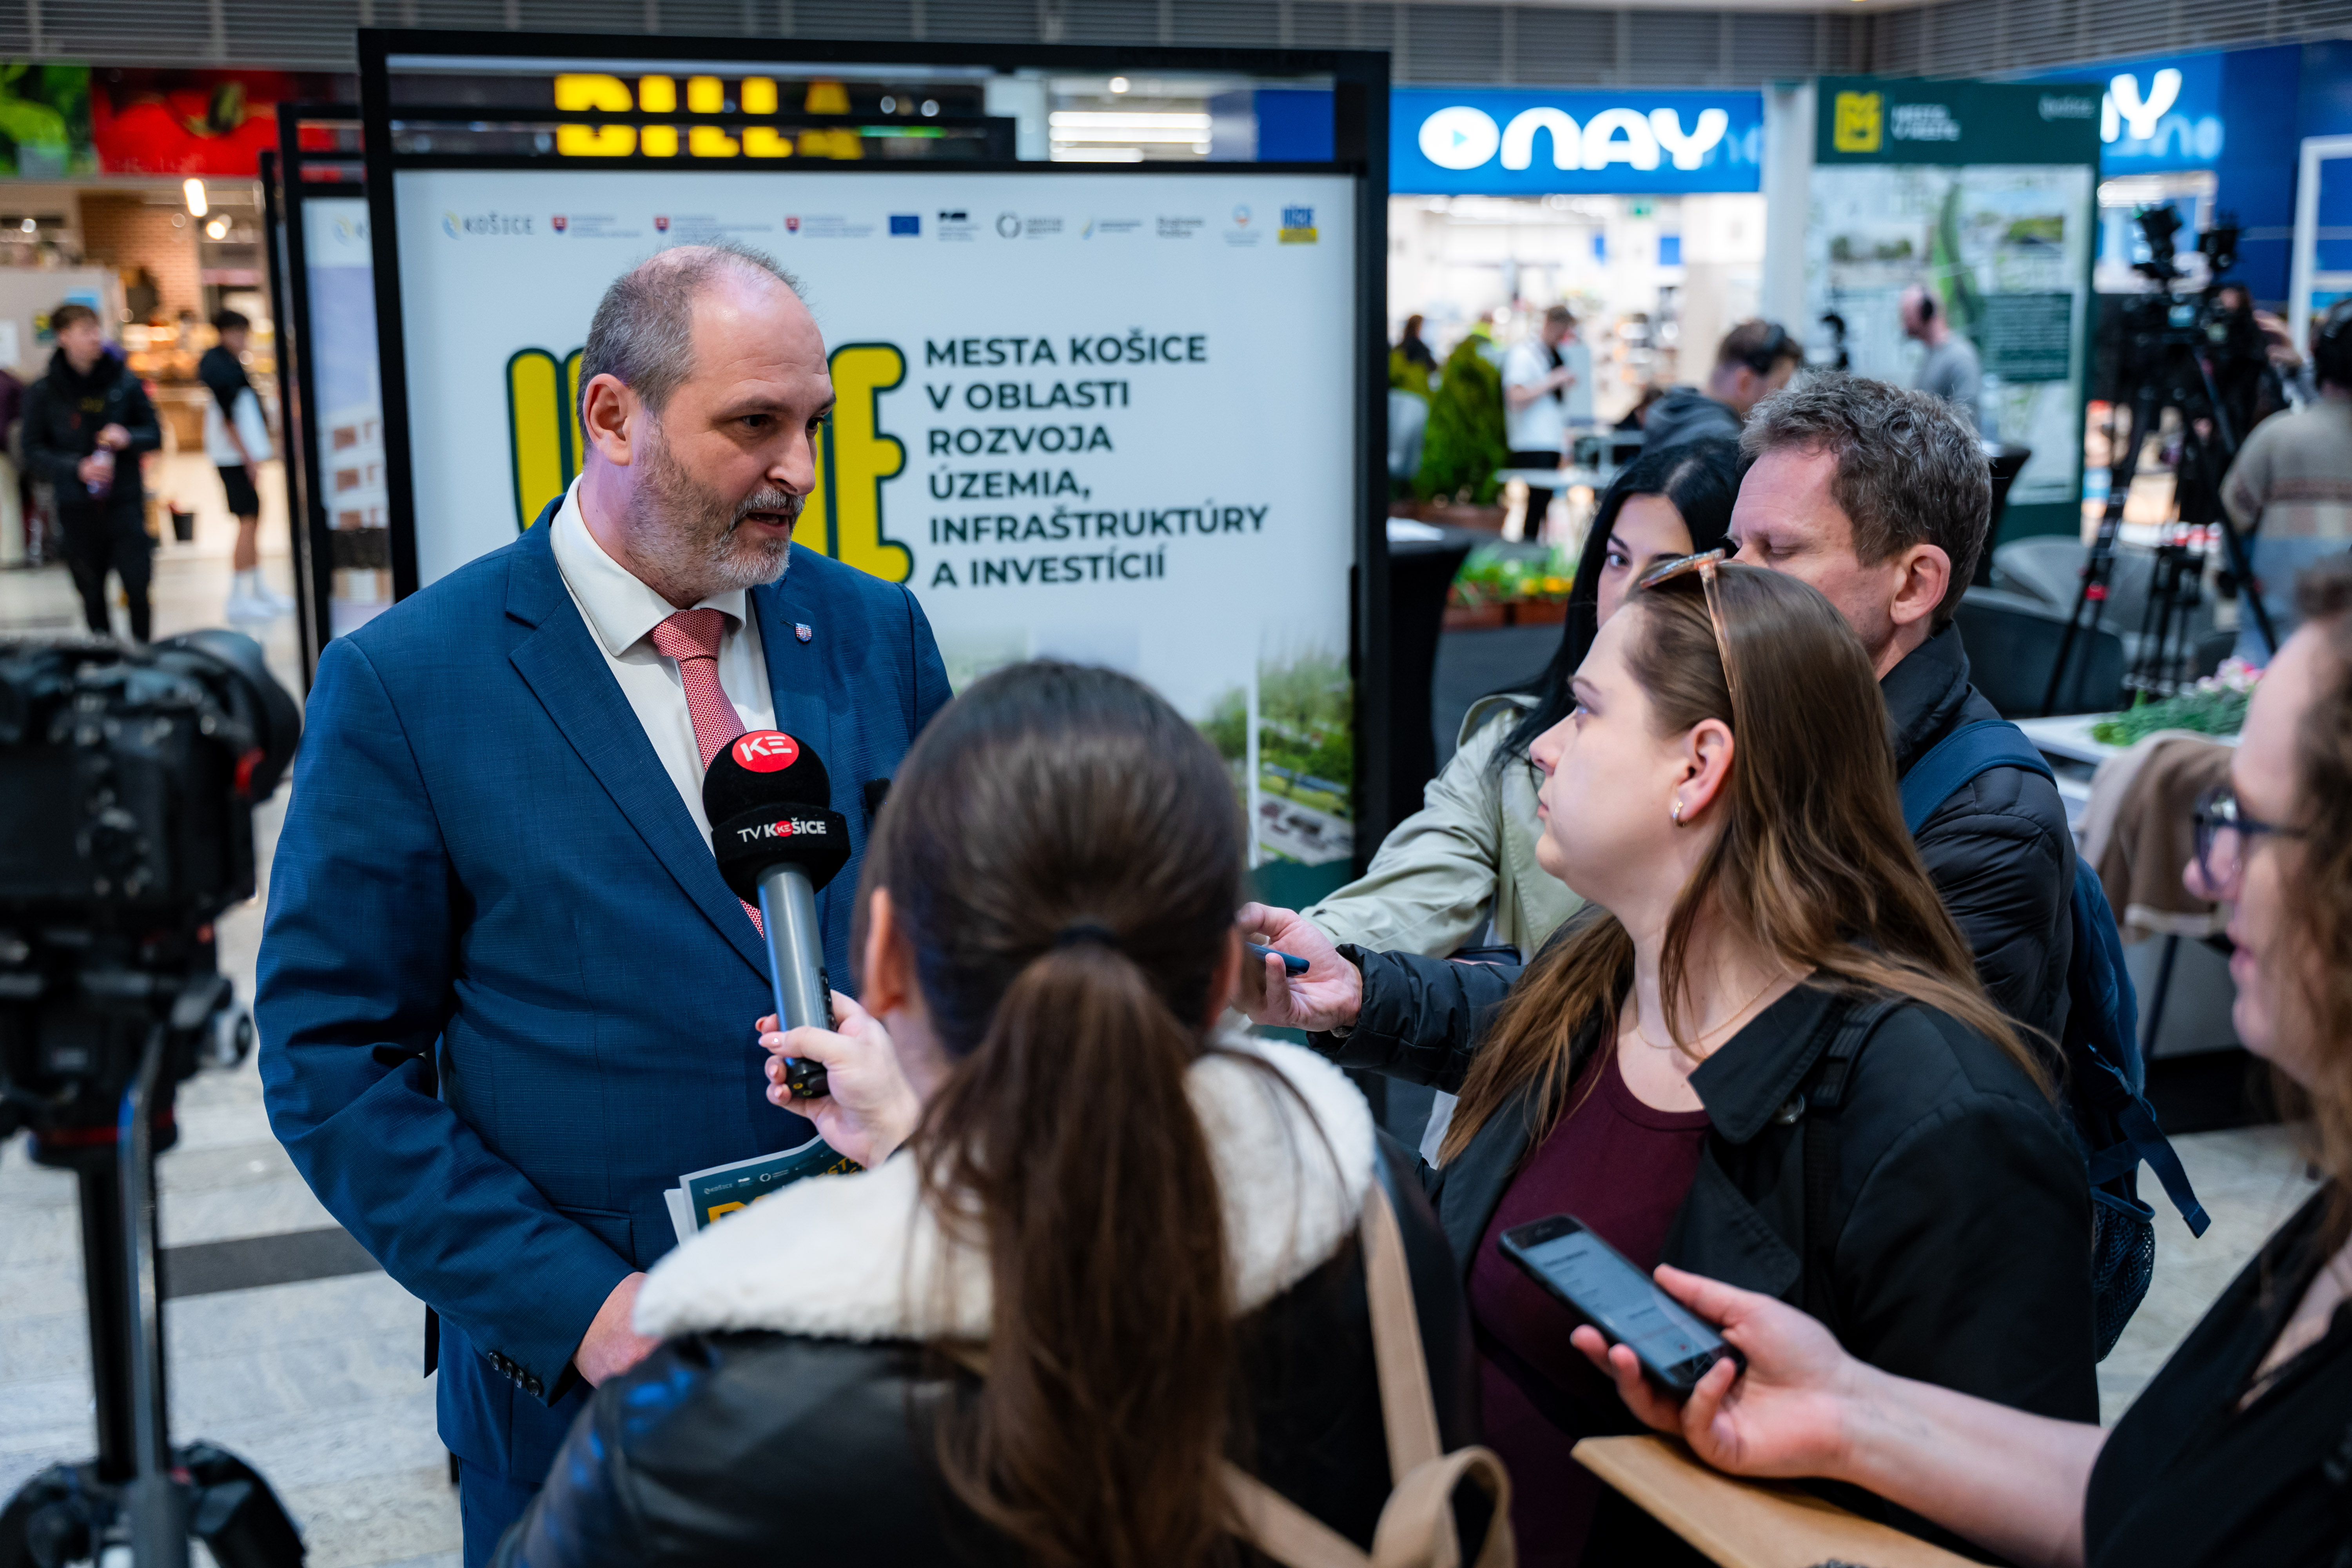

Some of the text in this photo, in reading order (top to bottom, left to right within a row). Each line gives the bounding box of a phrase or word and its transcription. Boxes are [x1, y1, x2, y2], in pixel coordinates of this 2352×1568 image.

[554, 73, 864, 160] BILLA
[463, 211, 534, 235] KOŠICE
[925, 328, 1207, 367] MESTA KOŠICE
[925, 380, 1129, 412] V OBLASTI
[928, 425, 1113, 456] ROZVOJA
[929, 464, 1091, 501] ÚZEMIA,
[930, 498, 1269, 545] INFRAŠTRUKTÚRY
[931, 543, 1165, 588] A INVESTÍCIÍ
[740, 735, 792, 762] KE
[737, 825, 761, 842] TV
